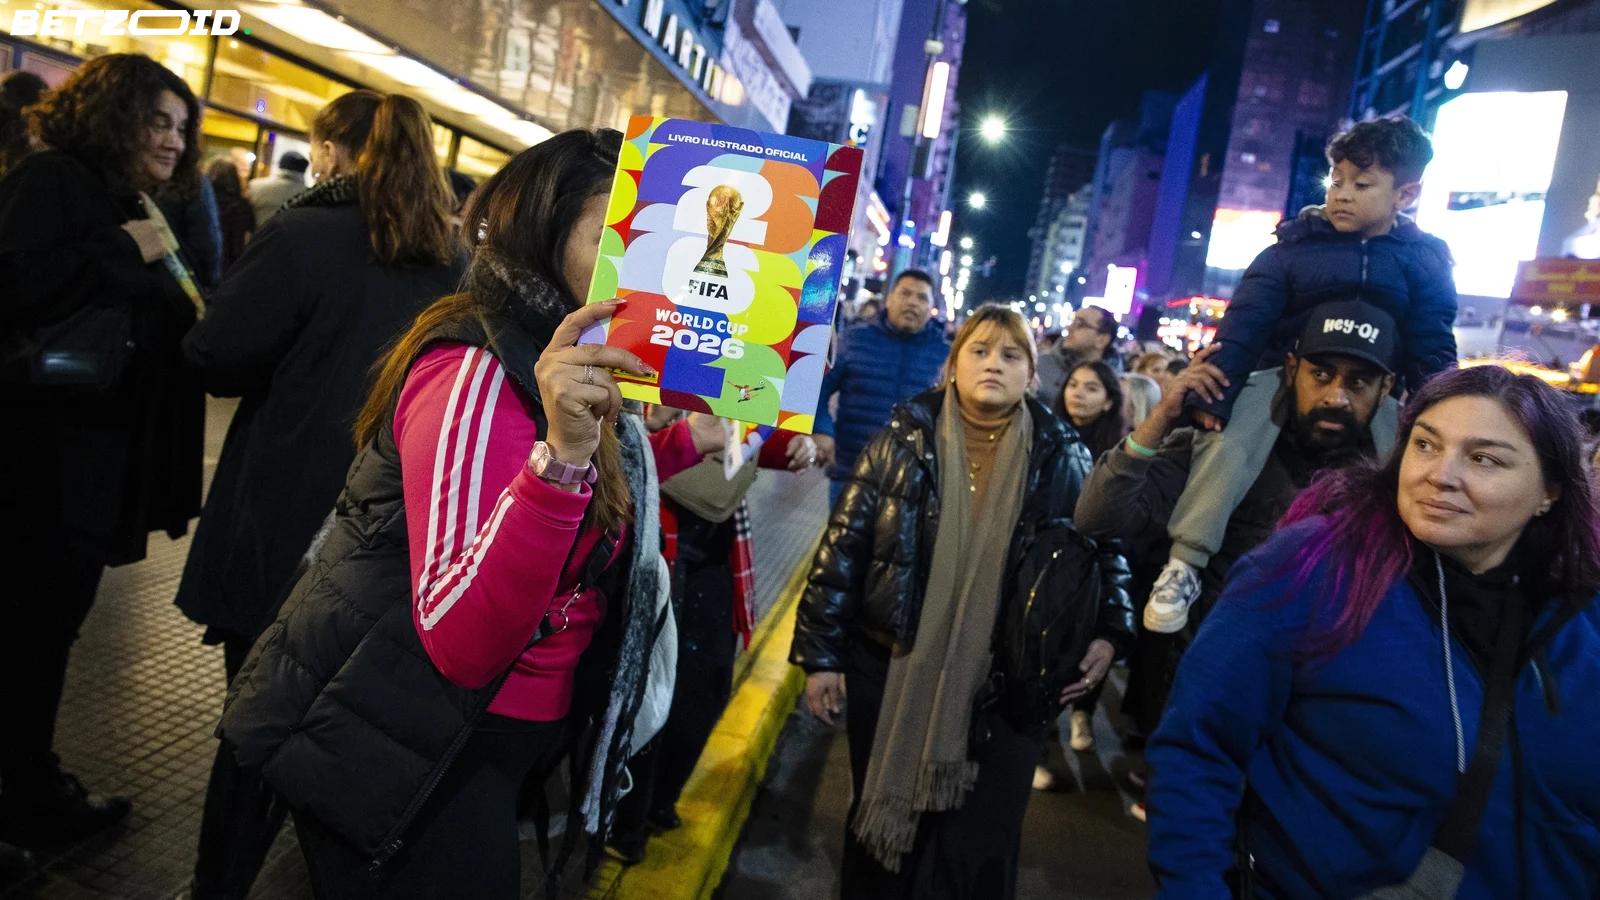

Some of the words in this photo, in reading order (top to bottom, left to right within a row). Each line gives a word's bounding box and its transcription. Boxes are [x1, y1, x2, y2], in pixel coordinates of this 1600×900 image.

[668, 133, 700, 145] LIVRO
[701, 138, 763, 154] ILUSTRADO
[765, 147, 808, 162] OFICIAL
[688, 279, 729, 300] FIFA
[656, 308, 714, 330] WORLD
[716, 320, 749, 336] CUP
[650, 324, 745, 359] 2026
